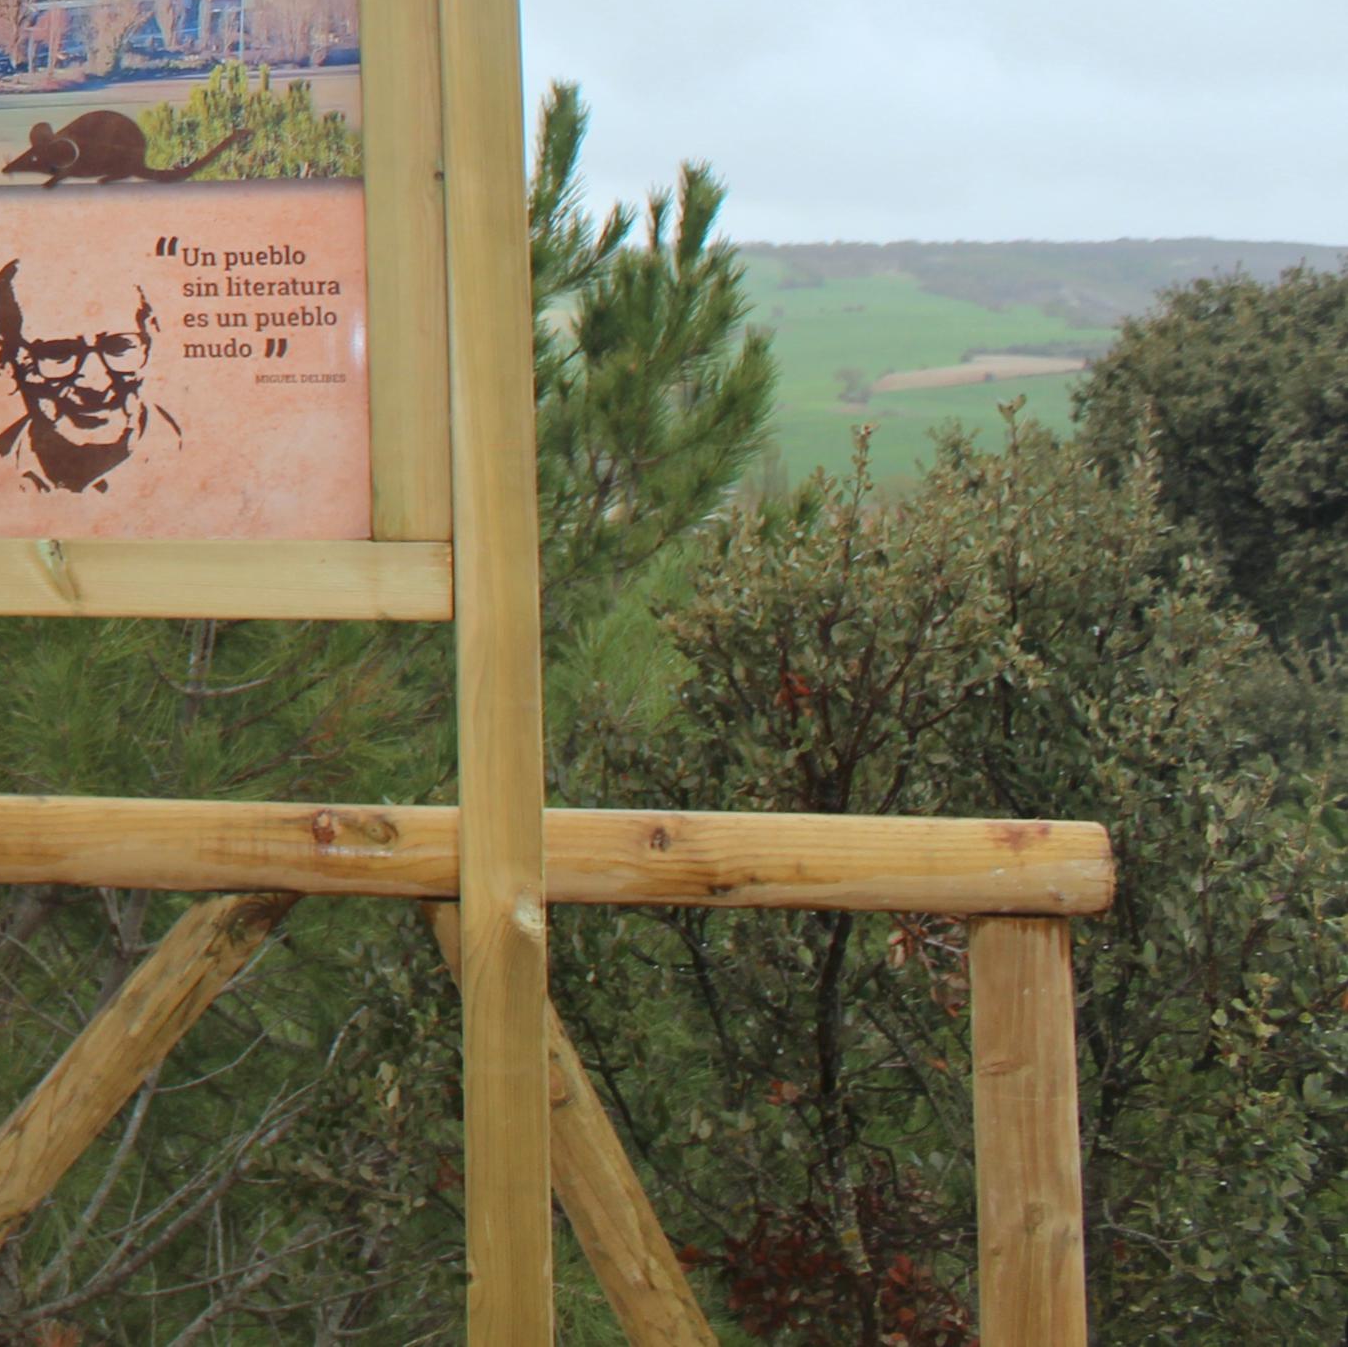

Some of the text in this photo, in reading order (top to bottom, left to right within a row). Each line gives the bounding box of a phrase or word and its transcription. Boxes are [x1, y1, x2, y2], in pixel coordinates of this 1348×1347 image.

[225, 245, 306, 271] pueblo
[182, 276, 341, 297] sin literatura
[183, 306, 337, 332] es un pueblo
[183, 338, 252, 358] mudo
